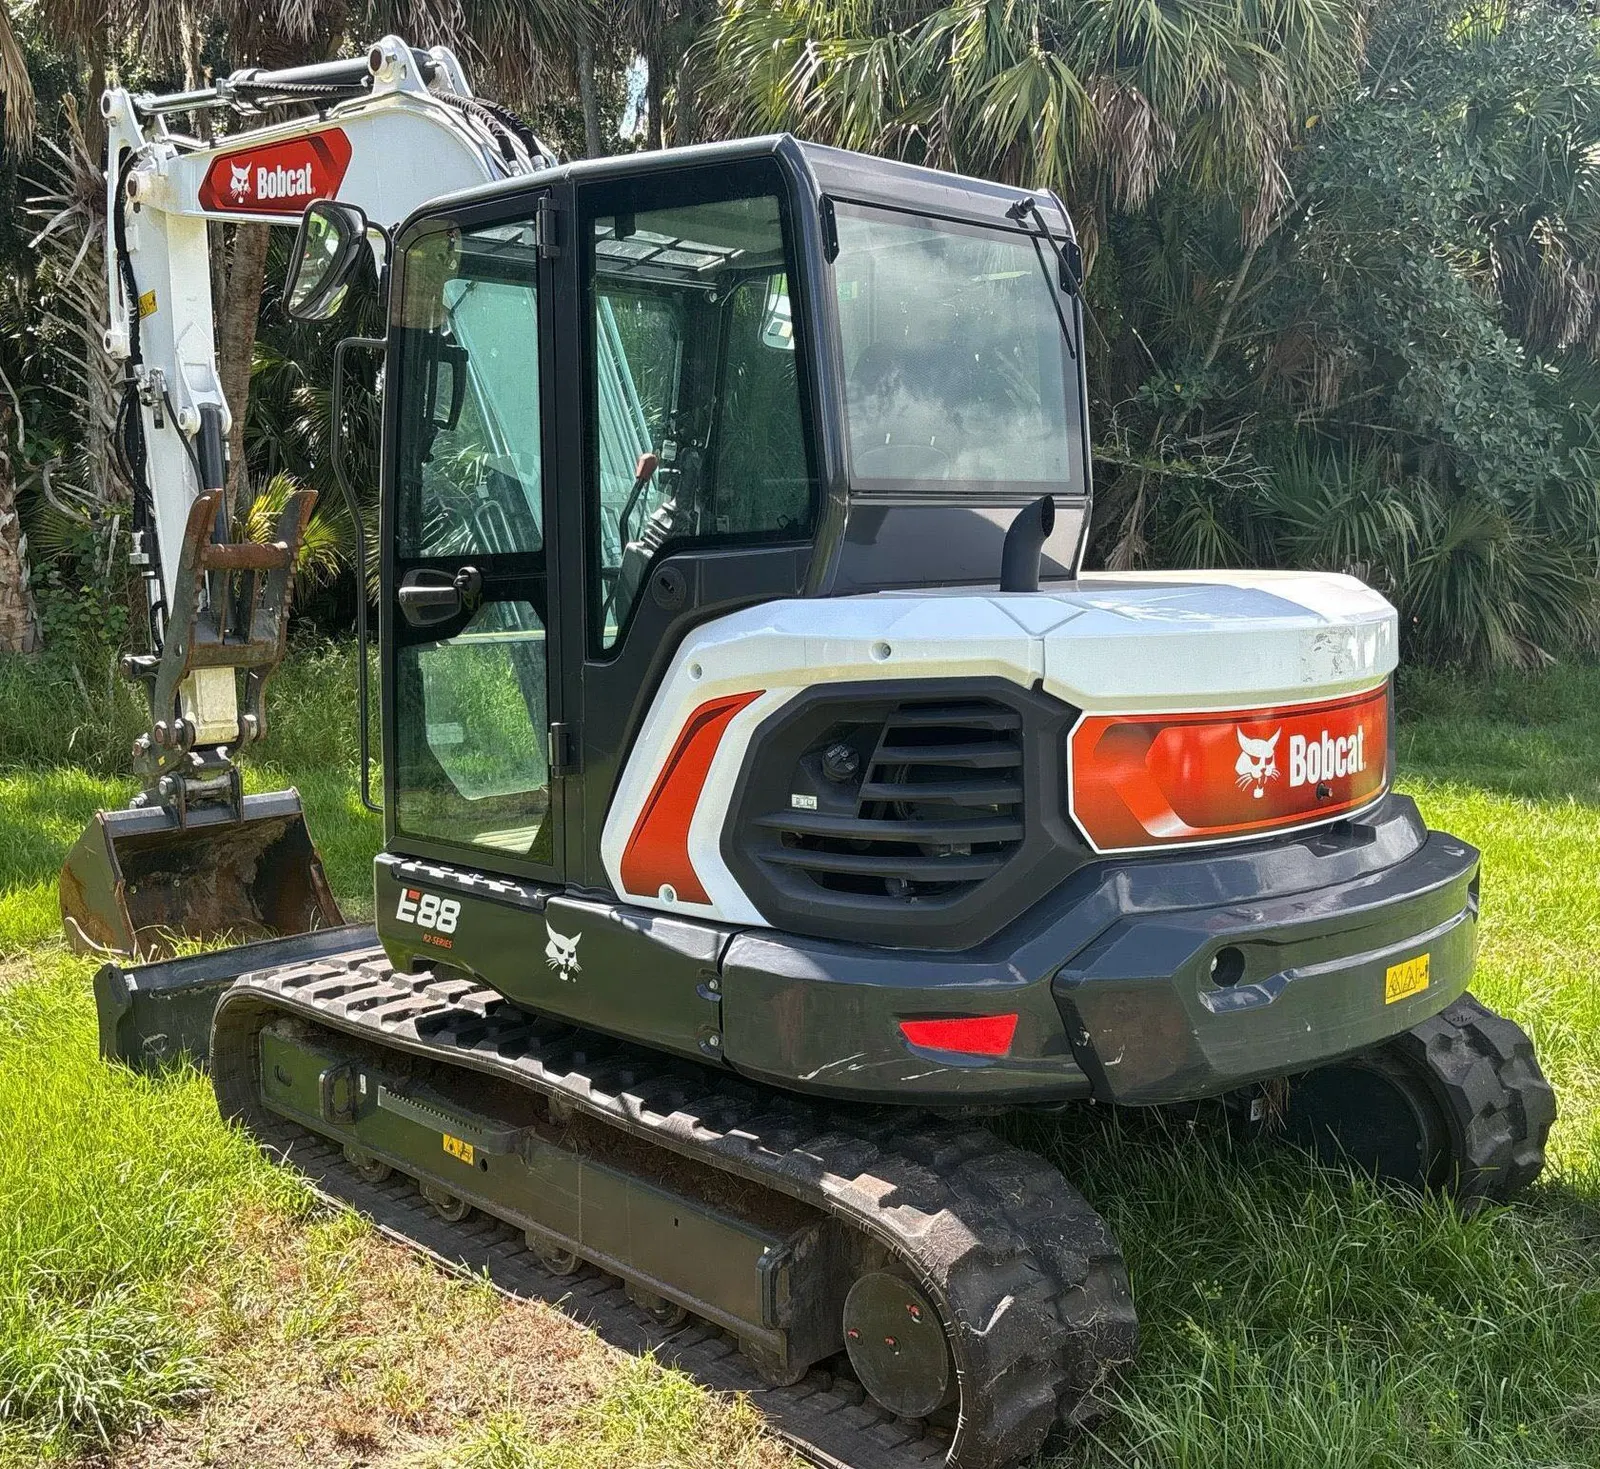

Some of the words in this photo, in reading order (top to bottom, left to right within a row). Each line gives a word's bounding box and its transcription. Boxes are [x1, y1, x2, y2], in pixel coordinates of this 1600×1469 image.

[257, 162, 312, 200] Bobcat
[1289, 724, 1364, 788] Bobcat
[395, 888, 462, 934] E88
[422, 933, 453, 949] R2-SERIES
